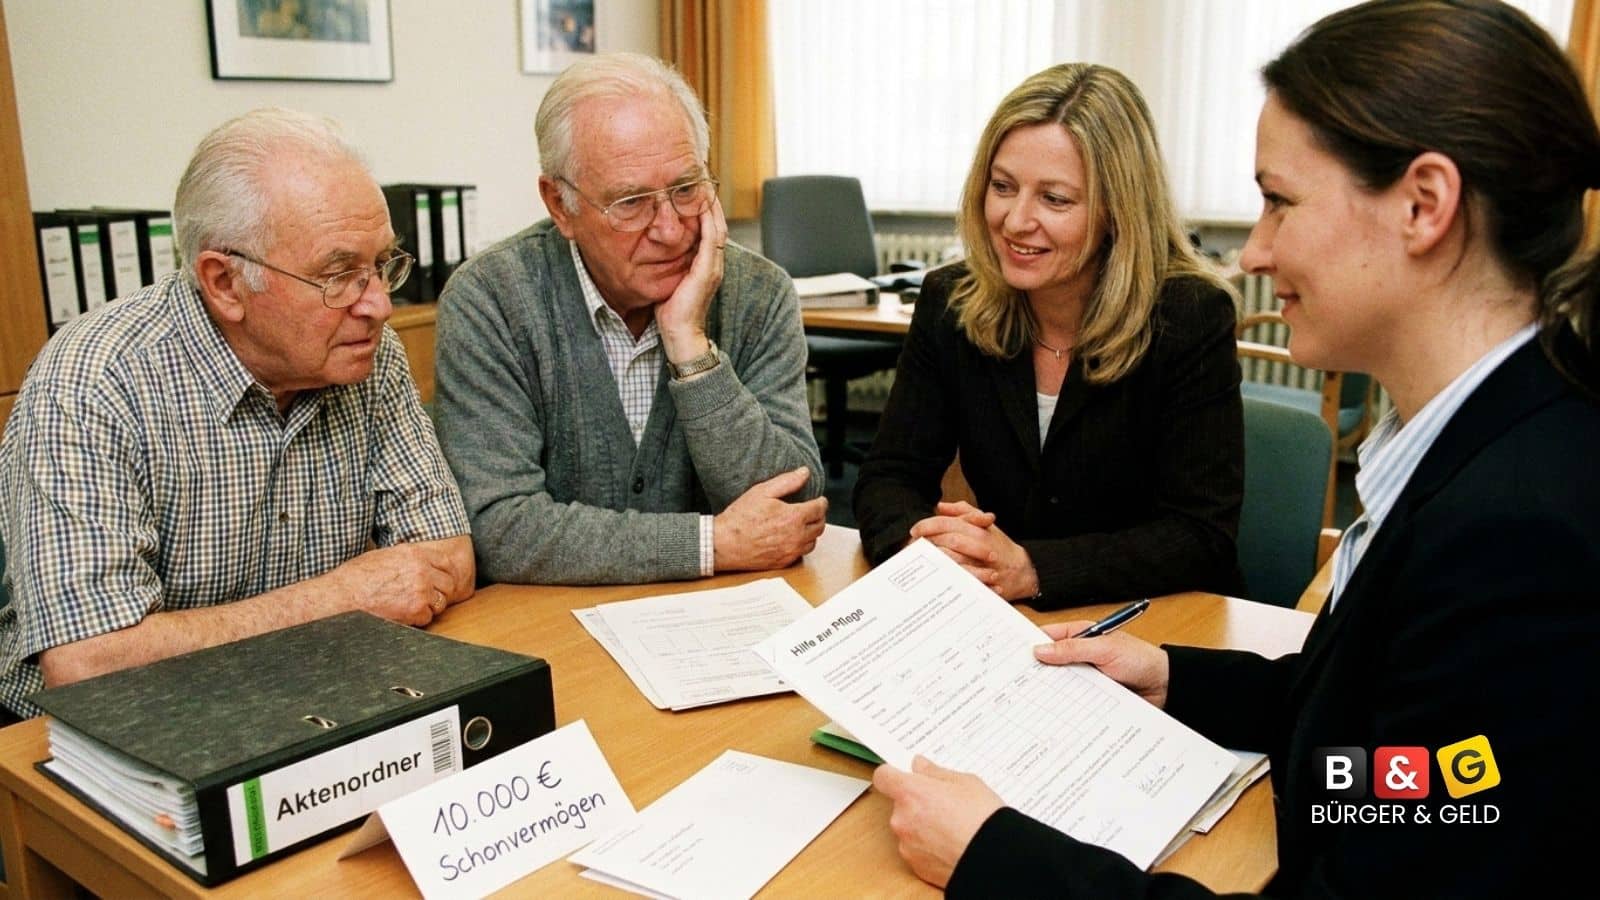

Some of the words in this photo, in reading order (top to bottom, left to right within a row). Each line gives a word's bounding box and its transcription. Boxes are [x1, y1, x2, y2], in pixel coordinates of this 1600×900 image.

[276, 750, 423, 821] Aktenordner
[432, 774, 531, 838] 10.000
[536, 760, 562, 790] €
[439, 791, 607, 882] Schonvermögen
